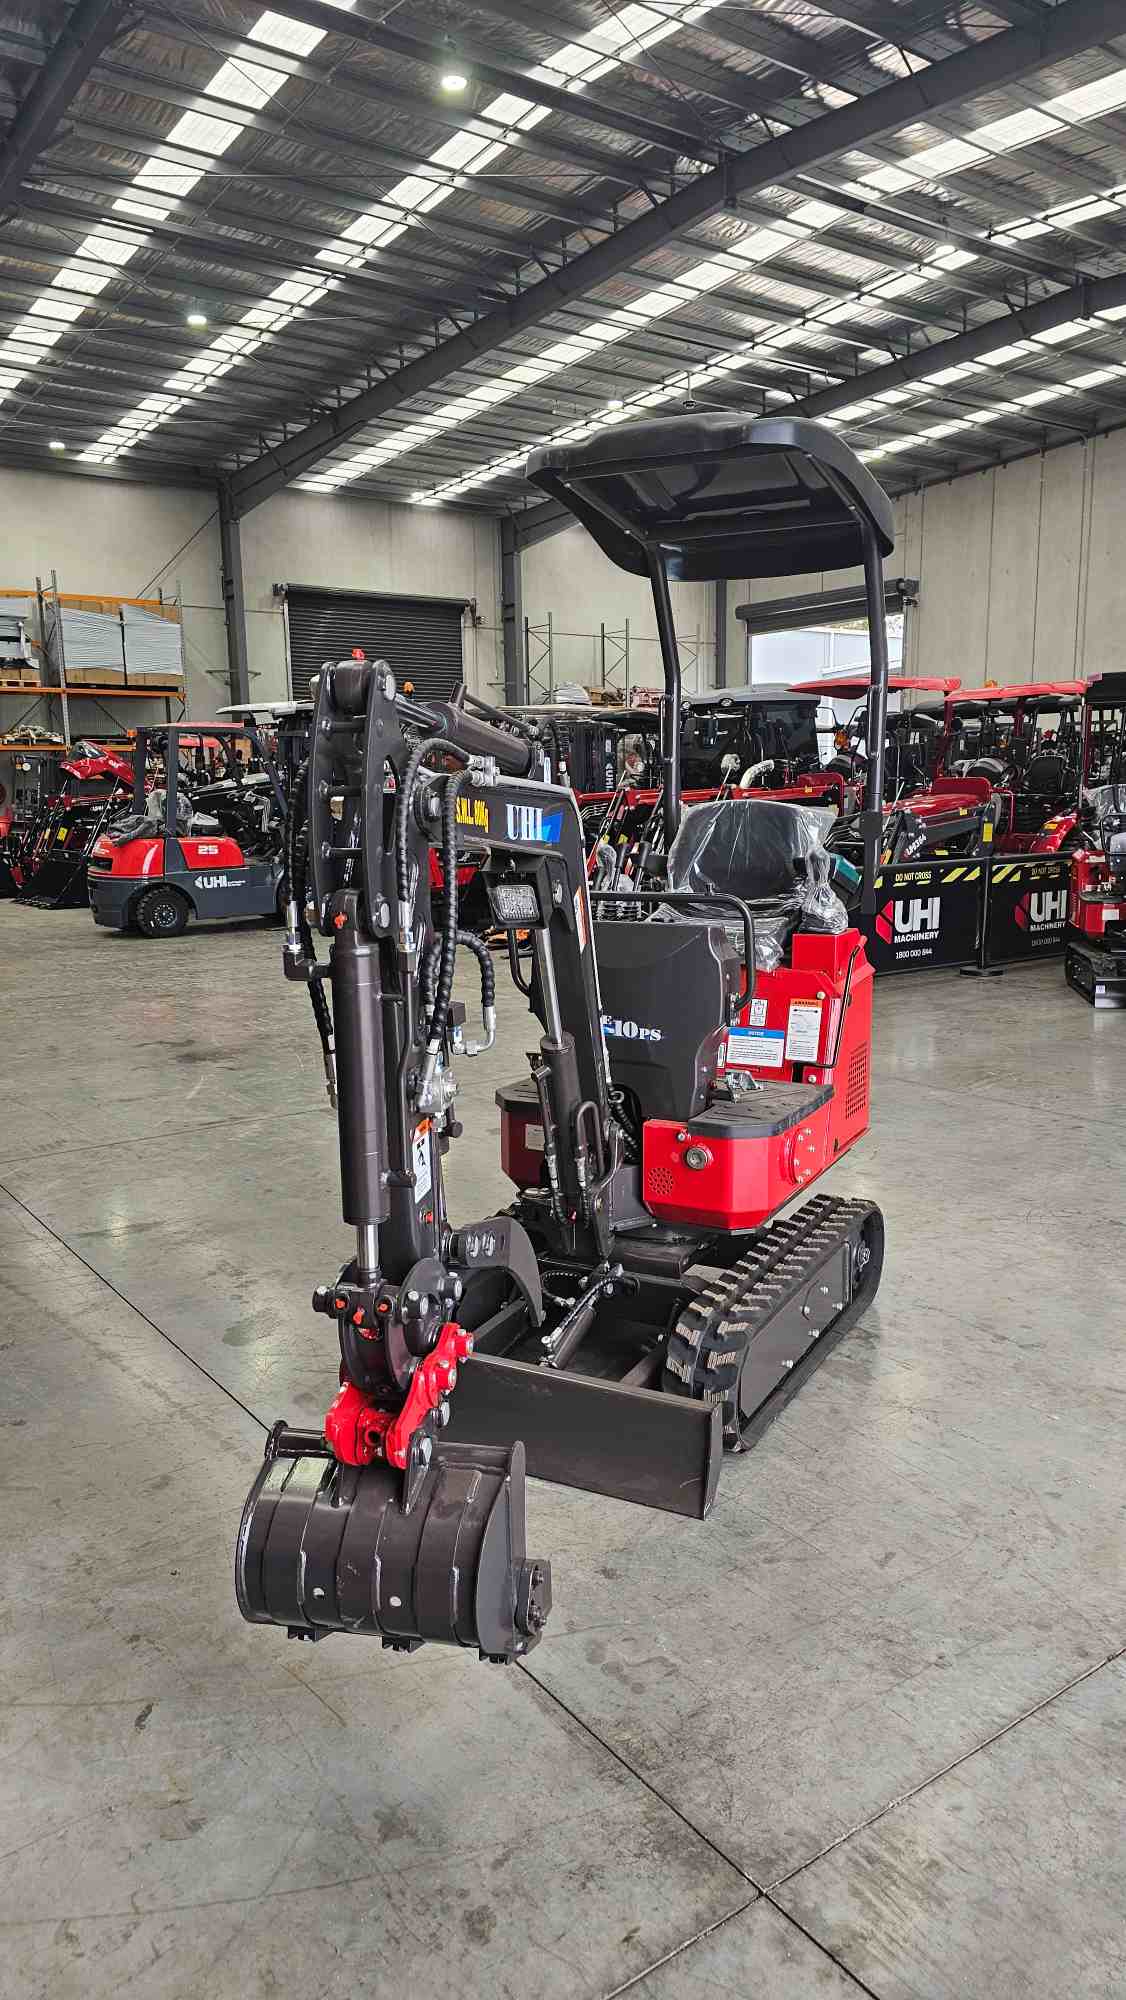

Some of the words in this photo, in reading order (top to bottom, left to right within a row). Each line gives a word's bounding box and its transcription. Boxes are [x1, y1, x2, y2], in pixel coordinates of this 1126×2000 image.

[505, 803, 544, 841] UHI
[198, 845, 219, 855] 25
[203, 875, 227, 888] UHI
[895, 873, 903, 882] DO
[903, 872, 914, 881] NOT
[914, 871, 932, 880] CROSS
[1030, 890, 1067, 922] UHI
[894, 896, 940, 933] UHI
[894, 931, 940, 944] MACHINERY
[895, 950, 910, 960] 1800
